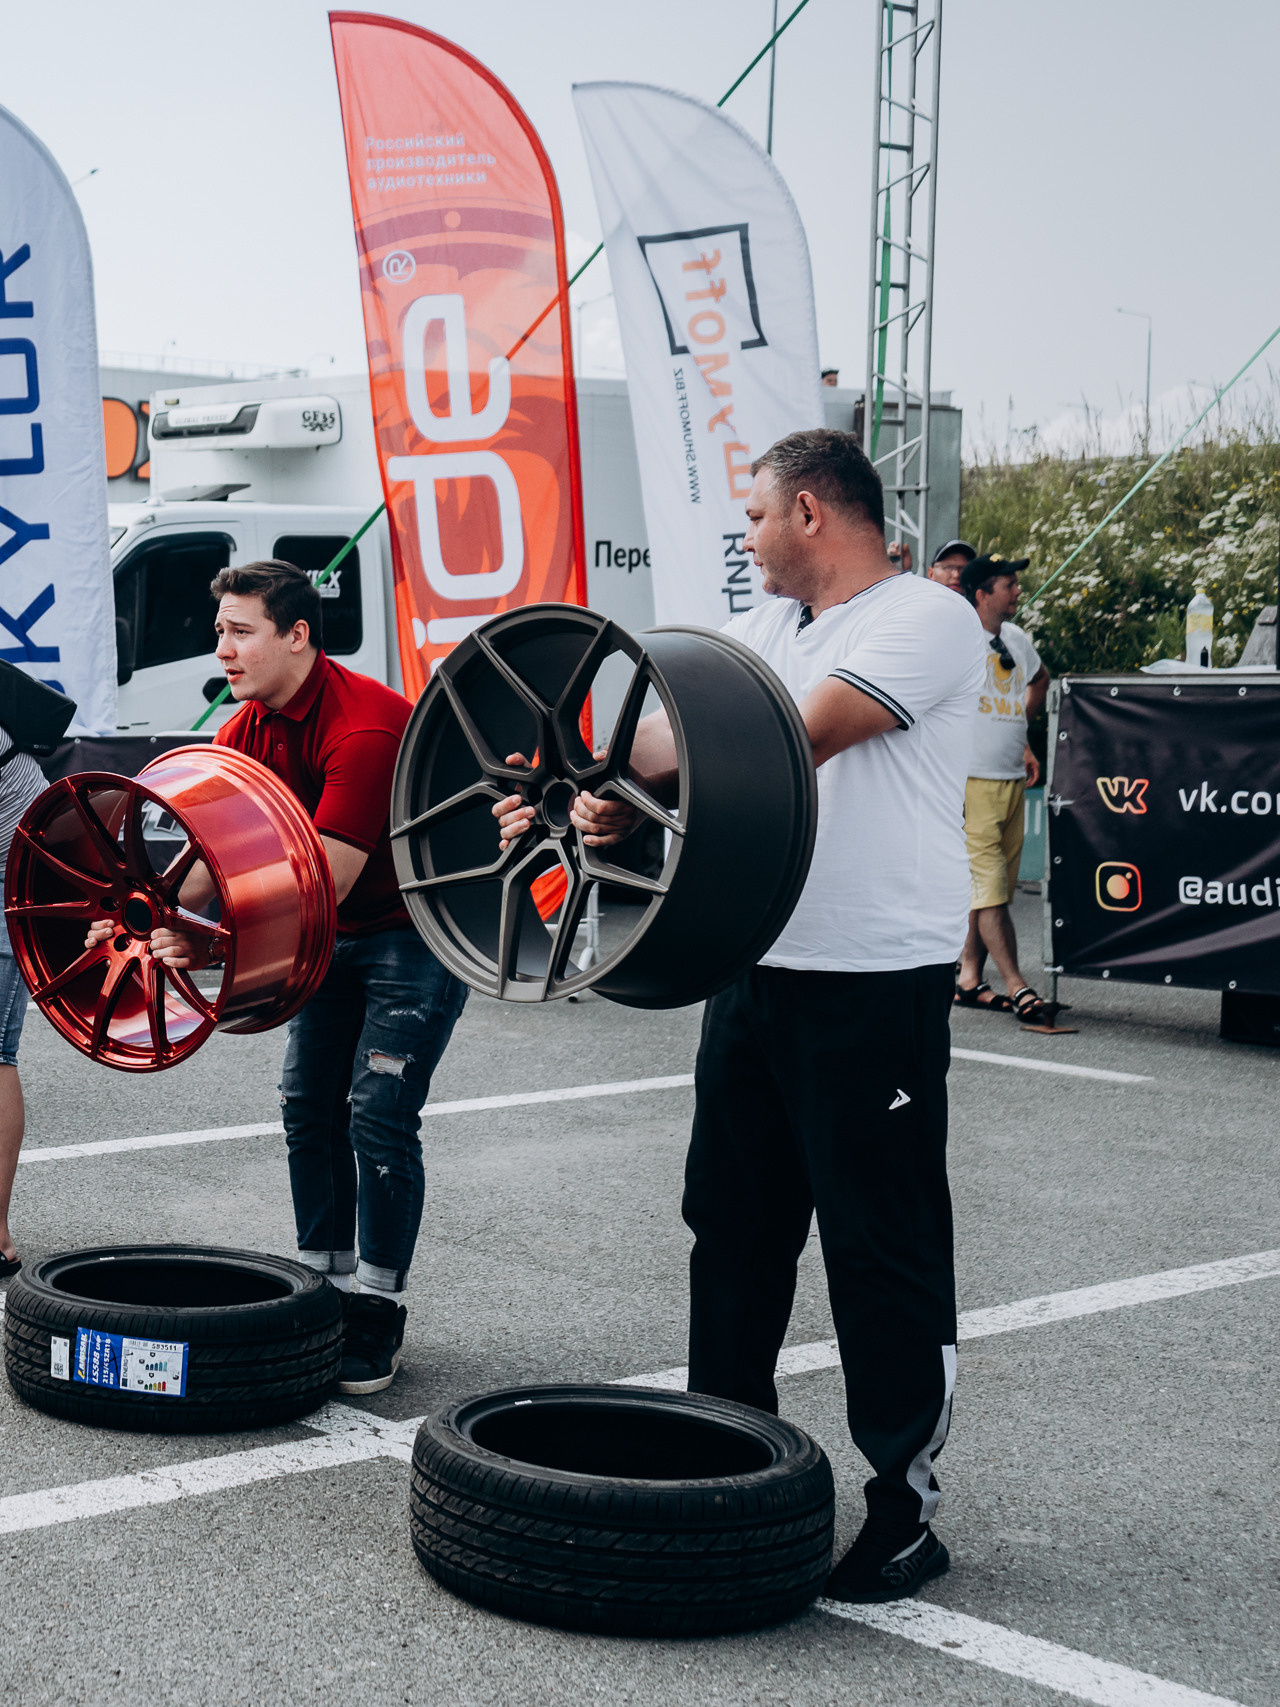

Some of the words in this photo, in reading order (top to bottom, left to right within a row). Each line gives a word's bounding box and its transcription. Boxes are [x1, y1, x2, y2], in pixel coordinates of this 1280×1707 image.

[365, 132, 465, 151] Российский
[366, 153, 496, 172] производитель
[367, 172, 487, 192] аудиотехники
[387, 293, 524, 676] ide
[1178, 781, 1280, 816] vk.co
[1178, 876, 1280, 907] @audi
[91, 1350, 100, 1383] LS588
